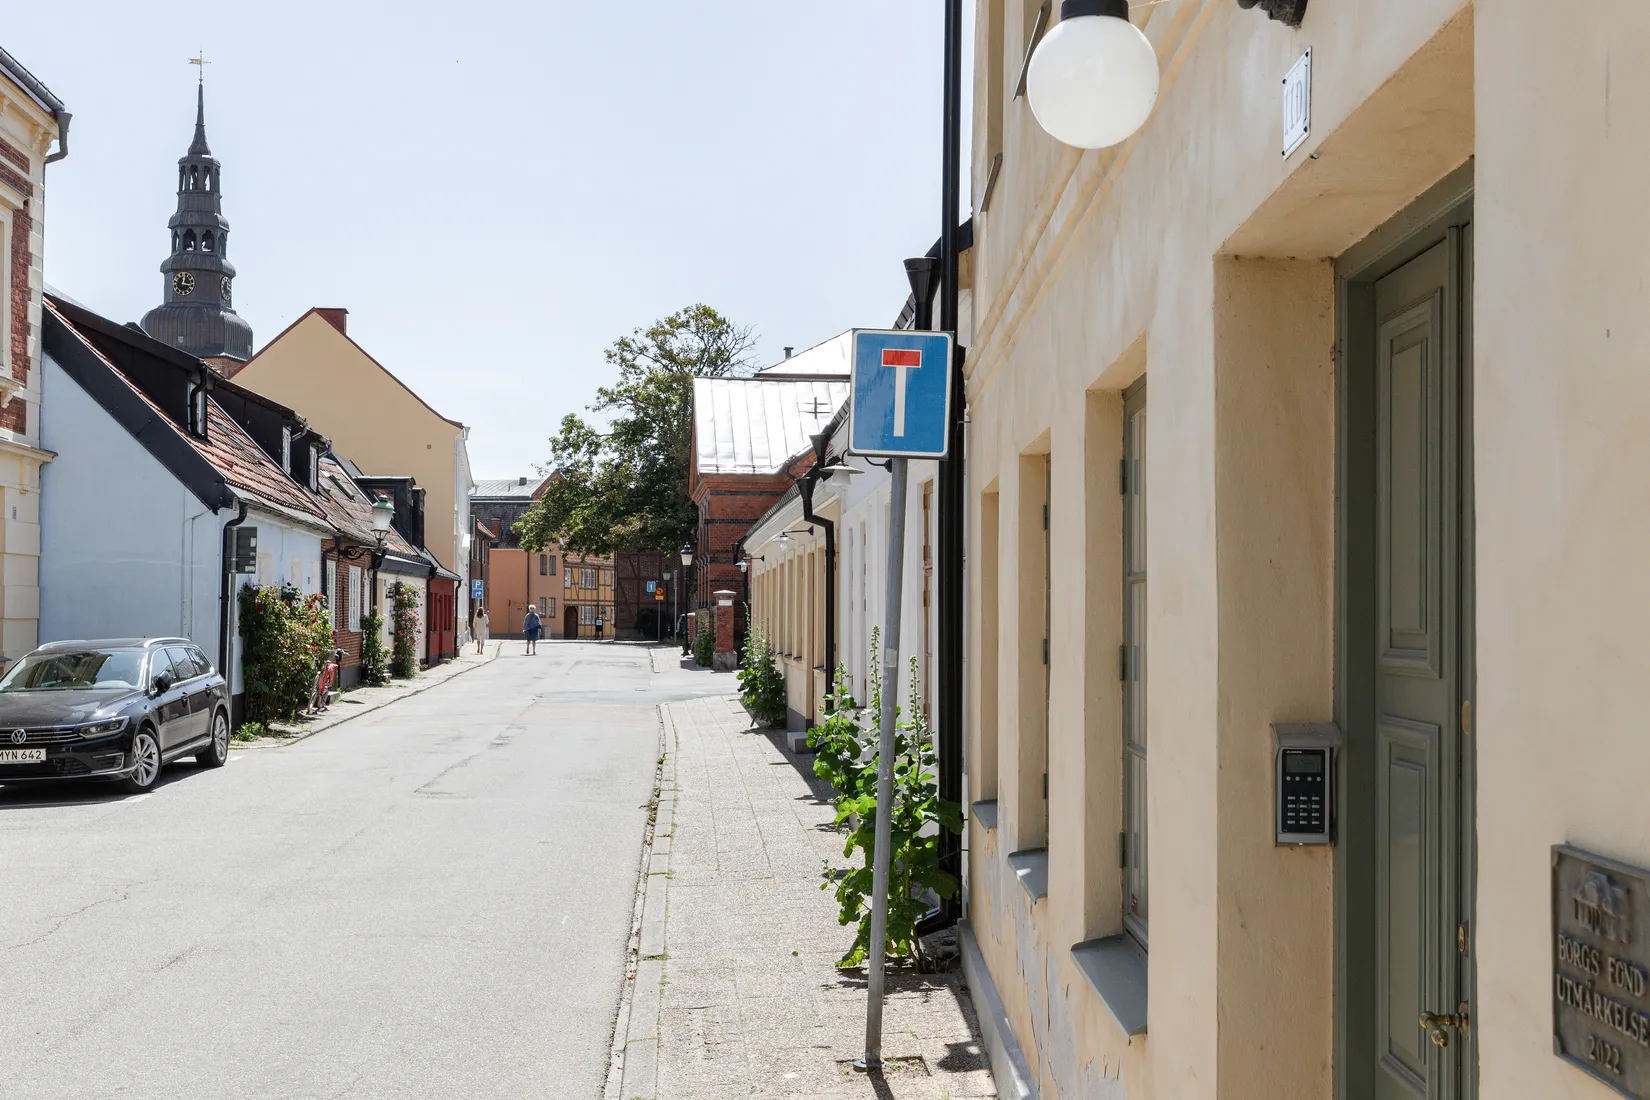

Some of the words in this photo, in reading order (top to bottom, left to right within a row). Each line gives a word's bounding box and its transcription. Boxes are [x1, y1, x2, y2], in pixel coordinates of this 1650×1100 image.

[1284, 79, 1303, 135] 11D
[21, 750, 42, 760] 642
[1558, 933, 1600, 976] BORGS
[1608, 956, 1644, 997] FOND
[1556, 973, 1649, 1047] UTMÄRKELSE
[1587, 1035, 1620, 1074] 2022
